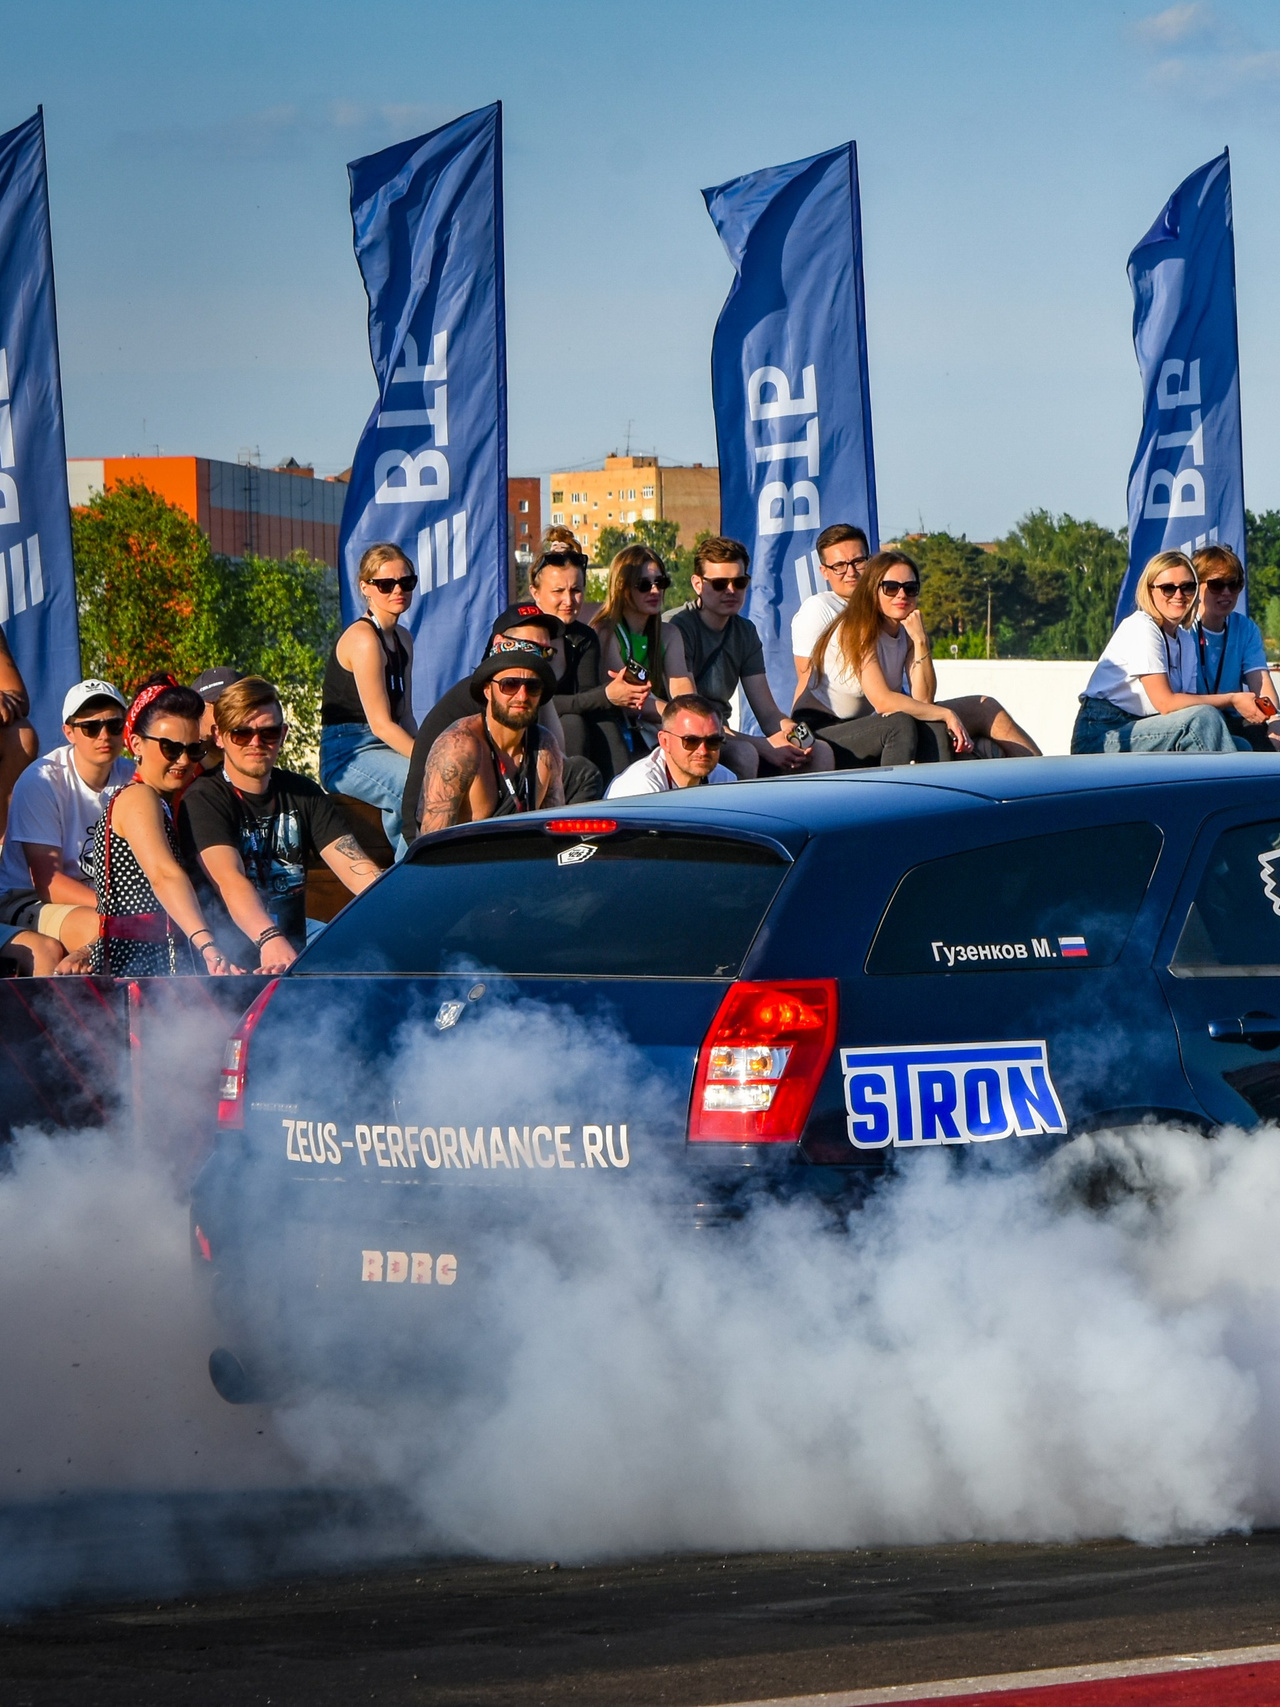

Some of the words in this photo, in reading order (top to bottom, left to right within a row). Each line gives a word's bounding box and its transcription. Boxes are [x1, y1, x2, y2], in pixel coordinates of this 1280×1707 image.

[931, 941, 1029, 966] Гузенков
[1031, 938, 1057, 958] М.
[845, 1046, 1063, 1143] STRON
[281, 1119, 631, 1170] ZEUS-PERFORMANCE.RU
[361, 1250, 458, 1285] RDRC
